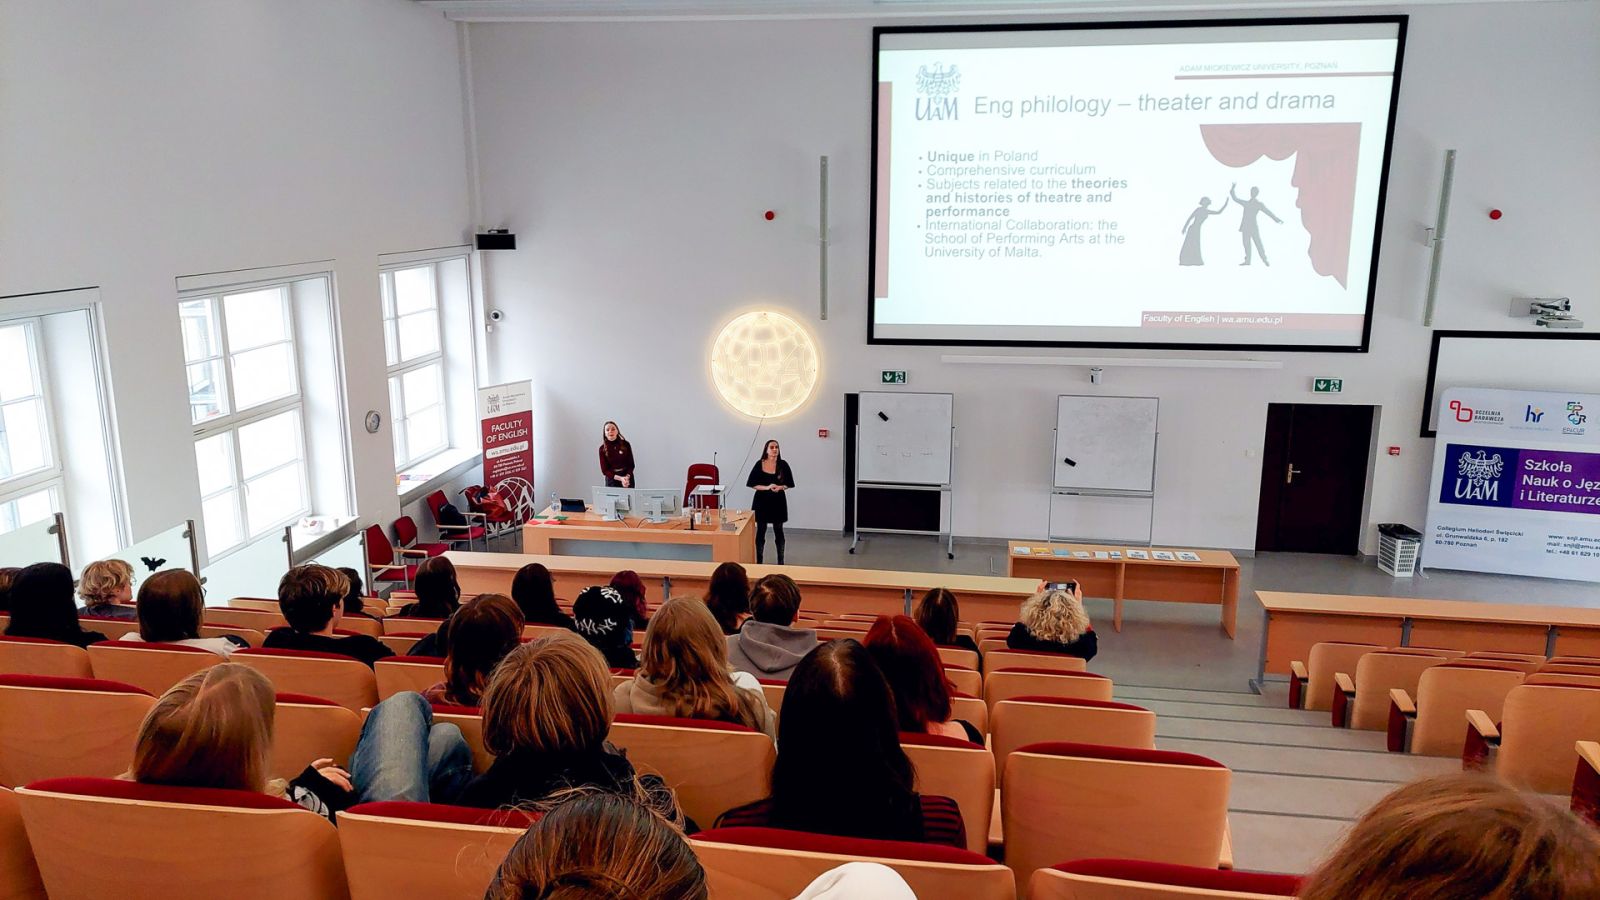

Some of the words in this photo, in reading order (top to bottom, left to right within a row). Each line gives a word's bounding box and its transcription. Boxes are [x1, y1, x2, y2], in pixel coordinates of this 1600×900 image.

[1204, 64, 1251, 72] MICKIEWICZ
[915, 97, 959, 121] UAM
[974, 96, 1013, 118] Eng
[1021, 95, 1111, 117] philology
[1138, 94, 1212, 111] theater
[1219, 92, 1259, 110] and
[1266, 91, 1335, 109] drama
[927, 151, 975, 163] Unique
[978, 150, 989, 161] in
[994, 150, 1039, 161] Poland
[926, 164, 1026, 178] Comprehensive
[1029, 164, 1096, 175] curriculum
[926, 178, 980, 192] Subjects
[984, 178, 1028, 190] related
[1031, 179, 1044, 189] to
[1047, 178, 1067, 189] the
[1071, 177, 1128, 189] theories
[926, 192, 950, 204] and
[955, 192, 1013, 203] histories
[1017, 192, 1031, 203] of
[1035, 192, 1082, 203] theatre
[1086, 192, 1112, 203] and
[926, 205, 1010, 219] performance
[926, 219, 1002, 231] International
[1006, 218, 1093, 230] Collaboration:
[1098, 219, 1118, 230] the
[925, 233, 967, 244] School
[971, 232, 983, 244] of
[987, 232, 1055, 247] Performing
[1059, 232, 1085, 244] Arts
[1089, 233, 1101, 244] at
[1105, 232, 1125, 244] the
[925, 246, 984, 260] University
[988, 246, 1002, 258] of
[1004, 246, 1042, 258] Malta.
[1143, 314, 1172, 324] Faculty
[1174, 314, 1183, 322] of
[1184, 315, 1215, 324] English
[1222, 316, 1283, 325] wa.amu.edu.pl
[491, 419, 523, 433] FACULTY
[486, 434, 498, 444] OF
[498, 428, 528, 441] ENGLISH
[1524, 459, 1572, 472] Szkoła
[1522, 474, 1559, 488] Nauk
[1562, 479, 1572, 488] o
[1454, 478, 1498, 501] UAM
[1520, 490, 1524, 500] i
